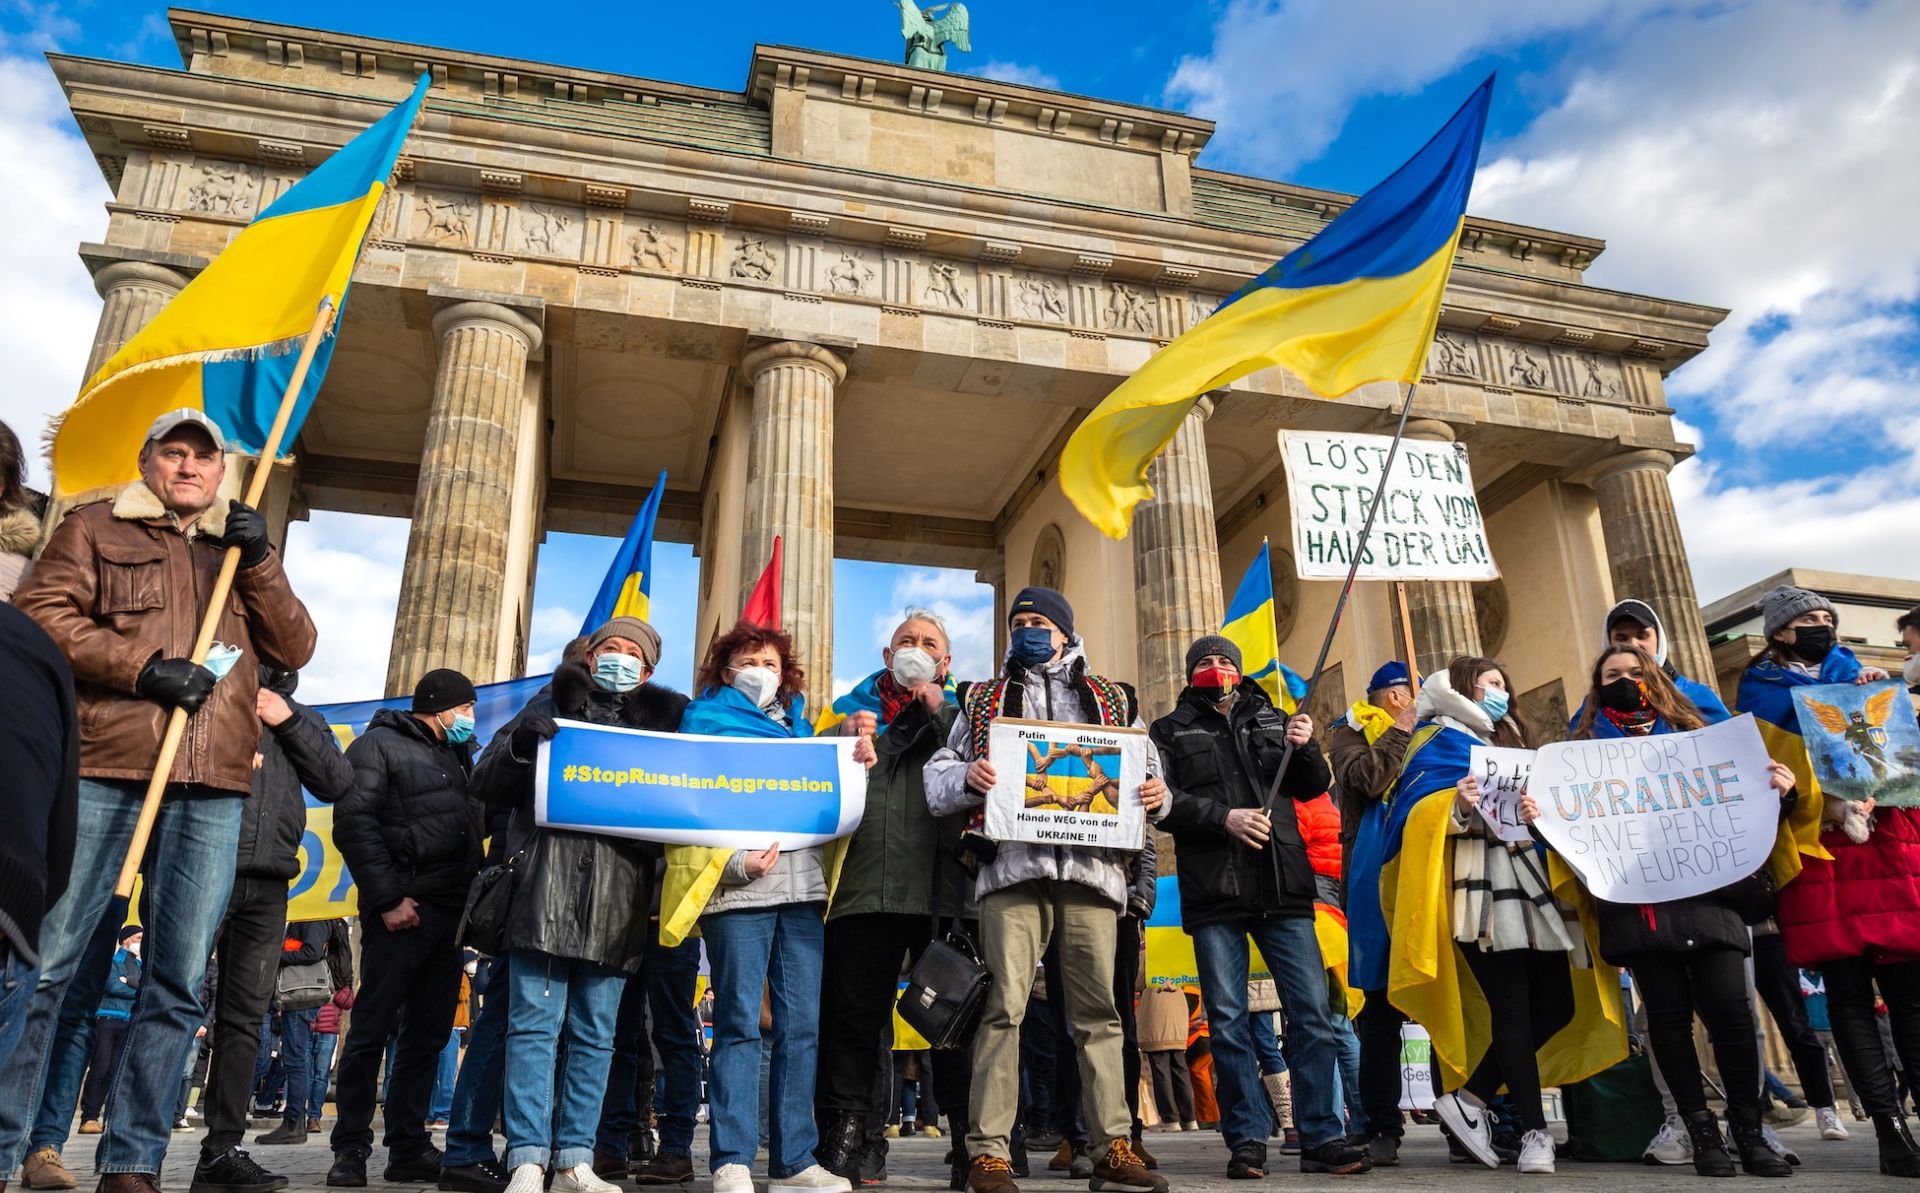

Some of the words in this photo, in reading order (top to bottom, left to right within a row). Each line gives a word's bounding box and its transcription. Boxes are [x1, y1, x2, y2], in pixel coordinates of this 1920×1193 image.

[1305, 439, 1388, 475] LÖST
[1406, 451, 1463, 484] DEN
[1311, 484, 1428, 525] STRICK
[1434, 494, 1481, 530] VOM
[1307, 530, 1374, 565] HALS
[1384, 531, 1438, 567] DER
[1018, 730, 1046, 740] Putin
[1076, 735, 1118, 746] diktator
[1484, 757, 1530, 795] Puti
[1561, 734, 1704, 782] SUPPORT
[563, 765, 834, 793] #StopRussianAggression
[1549, 760, 1744, 821] UKRAINE
[1017, 813, 1050, 823] Hände
[1053, 815, 1077, 825] WEG
[1101, 818, 1118, 828] der
[1036, 830, 1085, 841] UKRAINE
[1087, 833, 1097, 842] !!!
[1568, 820, 1643, 855] SAVE
[1659, 804, 1746, 845] PEACE
[1594, 855, 1628, 885] IN
[1639, 836, 1750, 883] EUROPE
[1403, 1067, 1430, 1081] Ges
